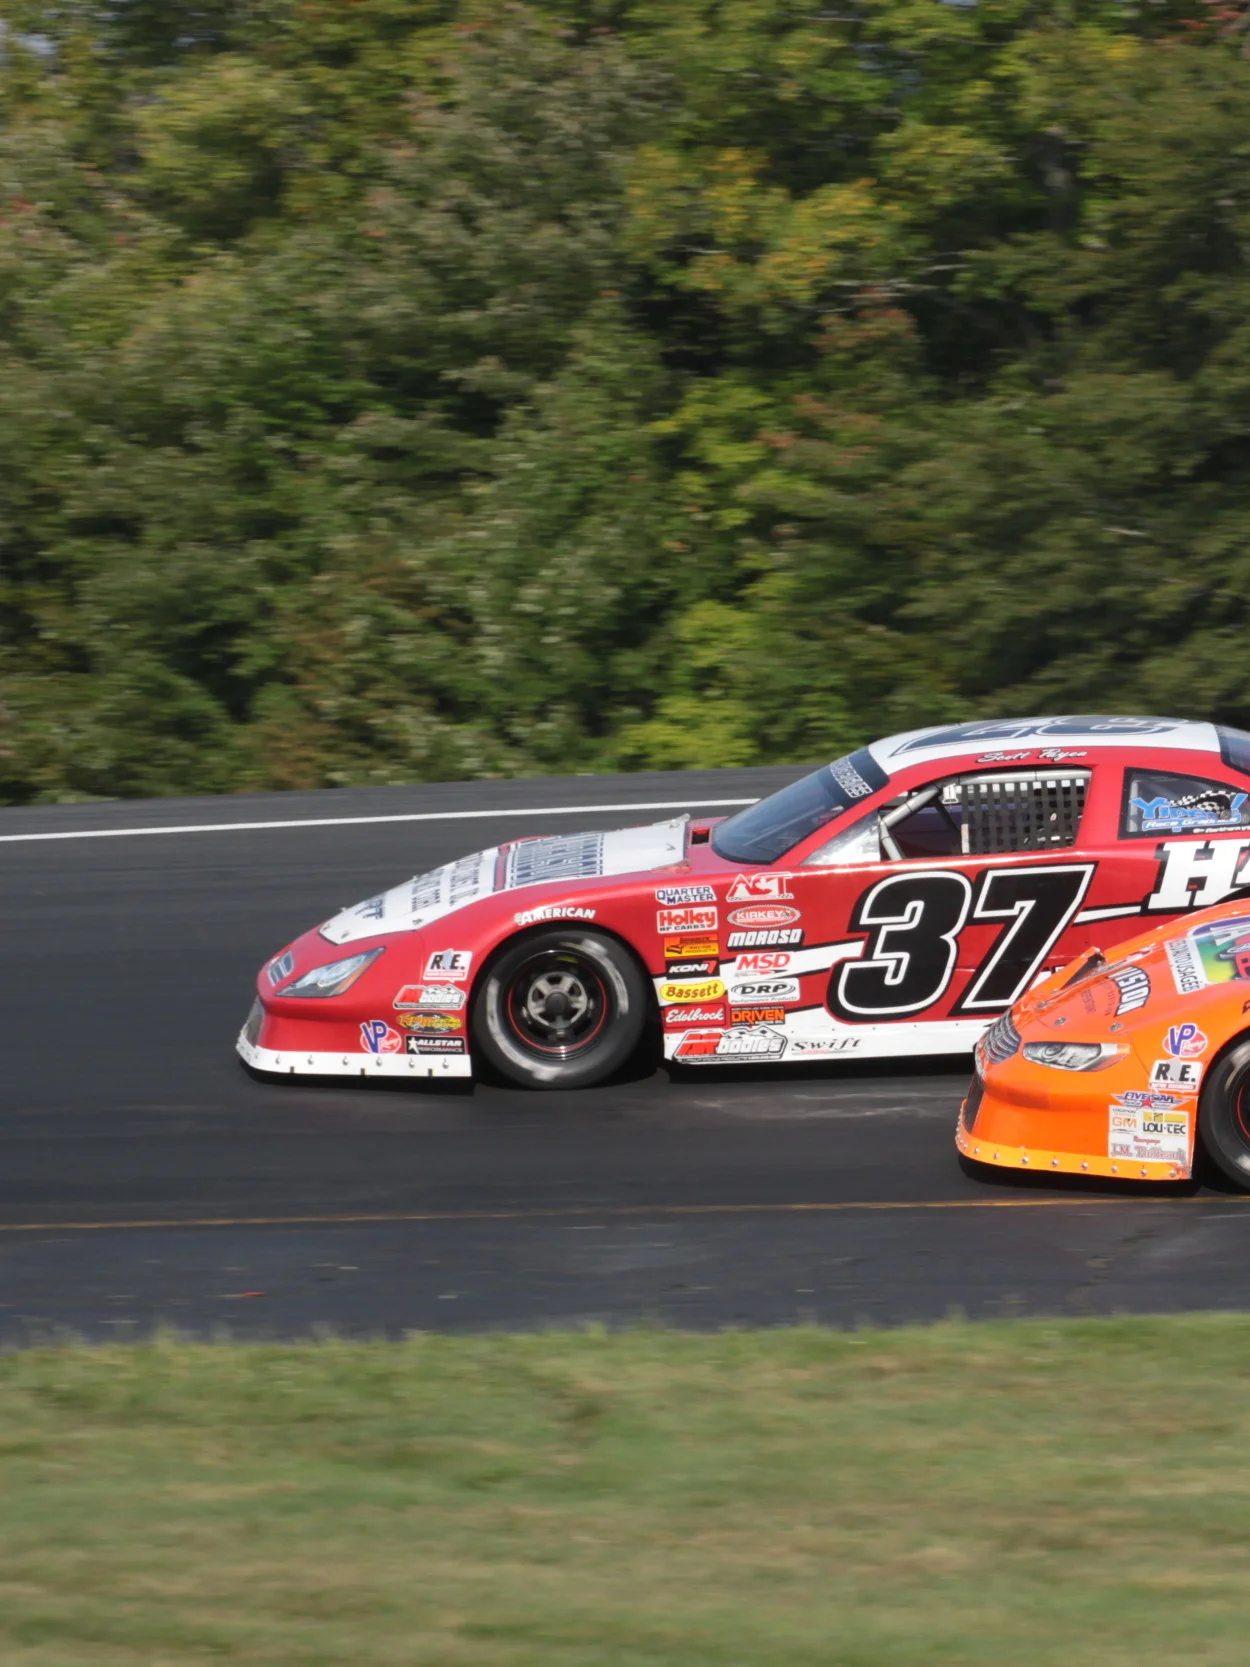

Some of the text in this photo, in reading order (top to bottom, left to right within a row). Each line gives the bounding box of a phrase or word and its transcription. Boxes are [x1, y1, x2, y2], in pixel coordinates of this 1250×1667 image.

[976, 751, 1032, 763] Scott
[1145, 820, 1179, 828] Race
[656, 886, 711, 901] QUARTER
[726, 872, 794, 901] ACT
[666, 894, 715, 905] MASTER
[517, 907, 597, 926] AMERICAN
[659, 910, 716, 929] Holley
[735, 910, 783, 919] KIRKEY
[727, 929, 803, 948] MOROSO
[830, 861, 1099, 1018] 37
[668, 964, 709, 974] KONI
[736, 953, 791, 971] MSD
[665, 982, 719, 999] Bassett
[740, 983, 788, 995] DRP
[665, 1008, 725, 1025] Edelbrock
[731, 1009, 785, 1024] DRIVEN
[360, 1020, 388, 1054] VP
[417, 1039, 463, 1047] ALLSTAR
[1168, 1023, 1197, 1057] VP
[1123, 1092, 1148, 1101] FIVE
